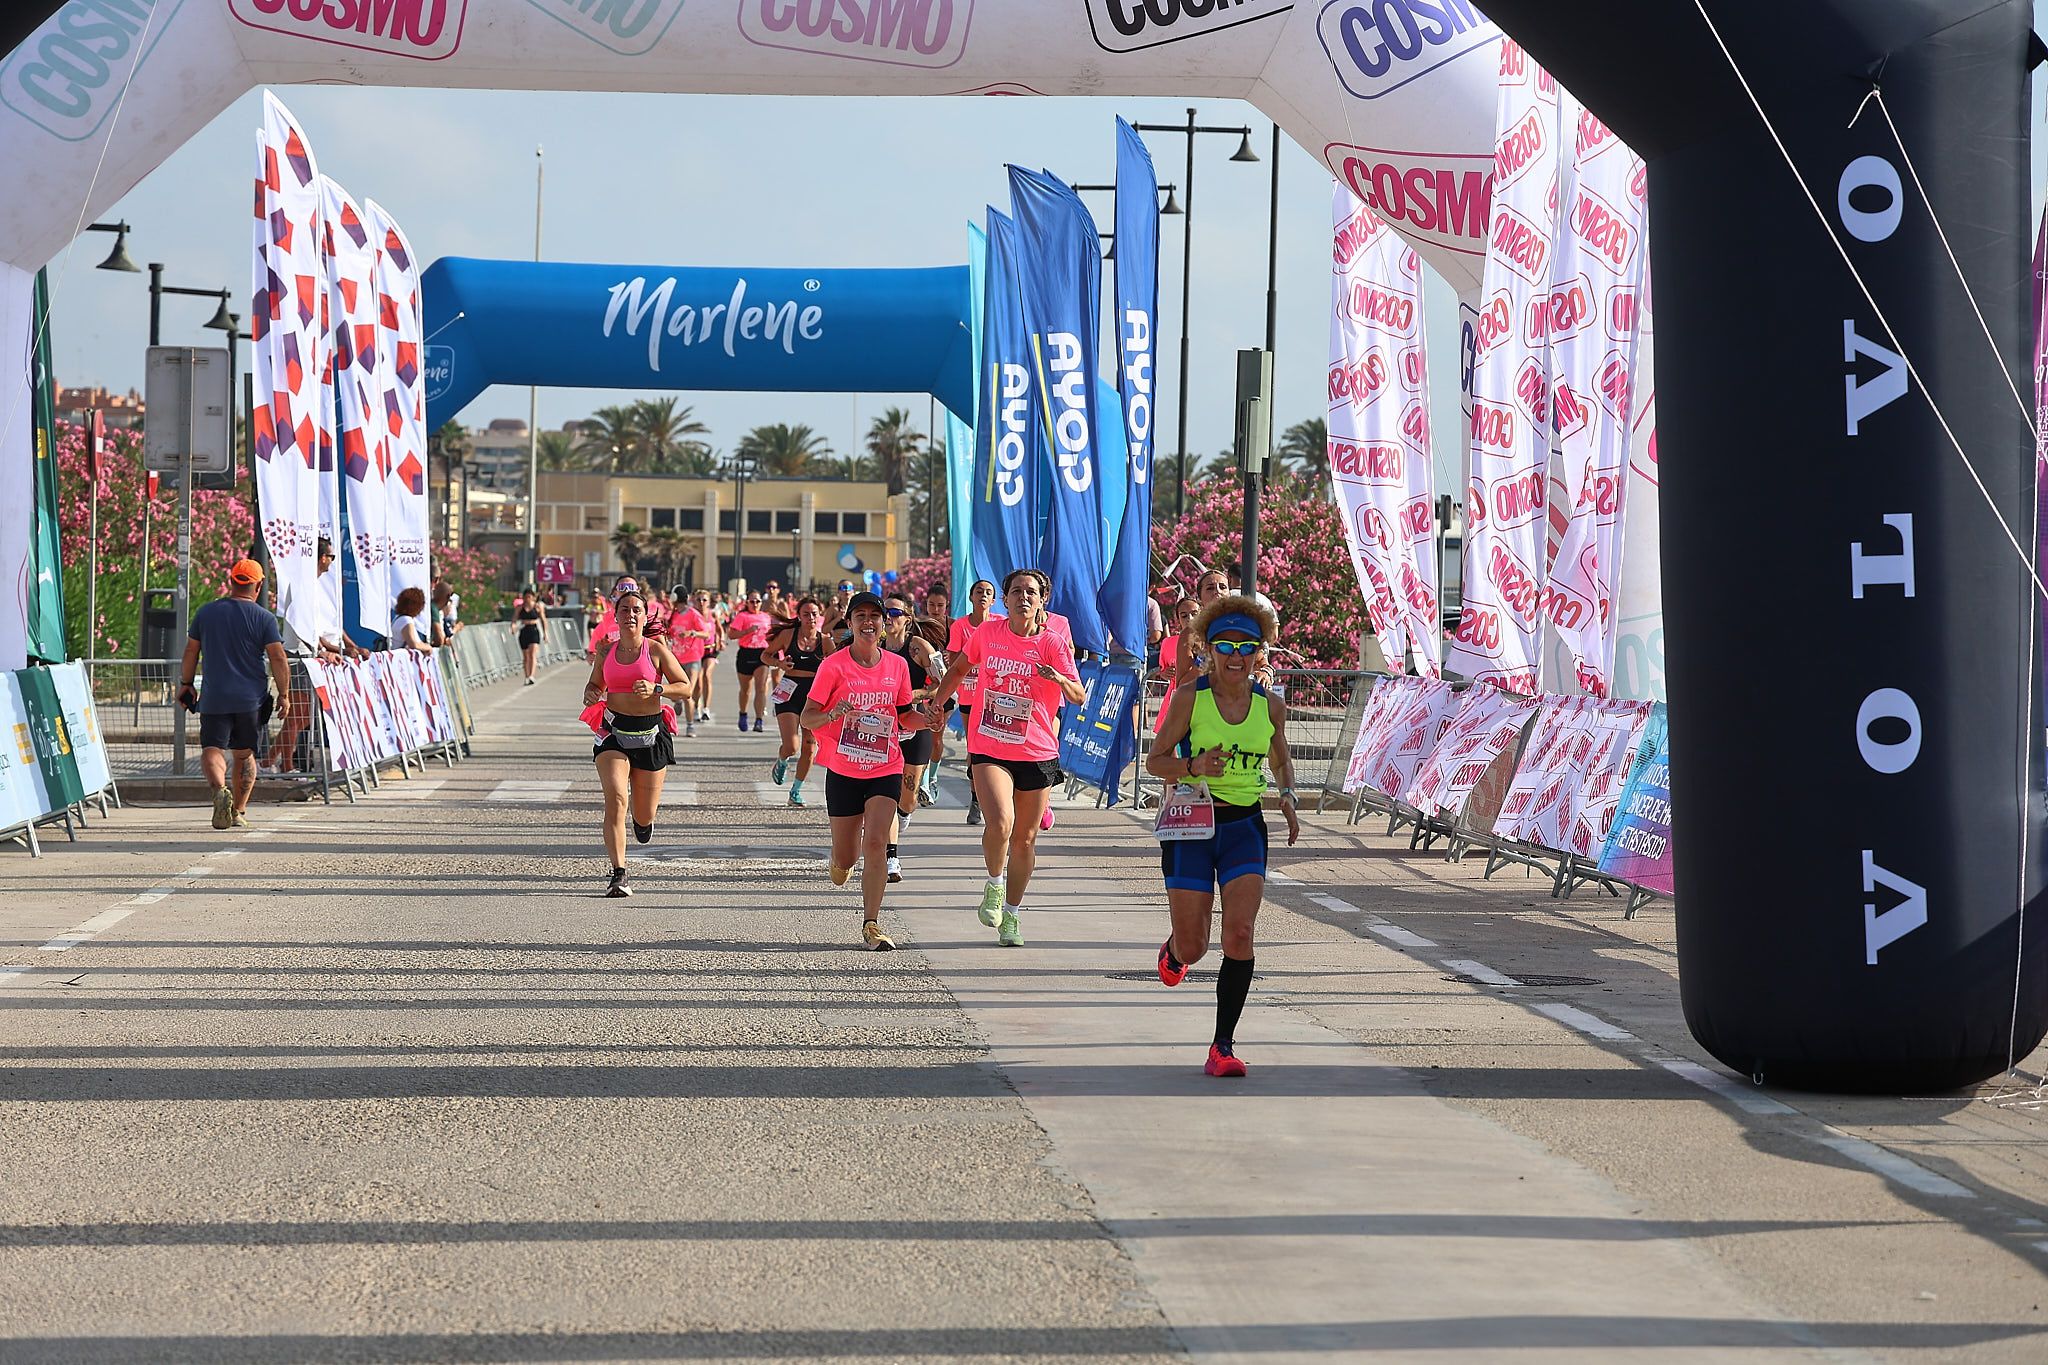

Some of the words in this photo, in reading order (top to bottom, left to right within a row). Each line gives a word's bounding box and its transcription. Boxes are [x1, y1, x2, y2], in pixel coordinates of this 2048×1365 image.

[1340, 0, 1492, 78] COSM
[18, 0, 158, 118] COSM
[603, 276, 823, 372] Marlene
[1838, 155, 1928, 965] VOLVO
[986, 655, 1033, 678] CARRERA
[847, 691, 894, 705] CARRERA
[994, 714, 1013, 725] 016
[858, 732, 877, 743] 016
[1451, 763, 1487, 786] COSMO
[1503, 792, 1533, 815] COSMO
[1533, 777, 1564, 815] COSMO
[1169, 805, 1193, 817] 016
